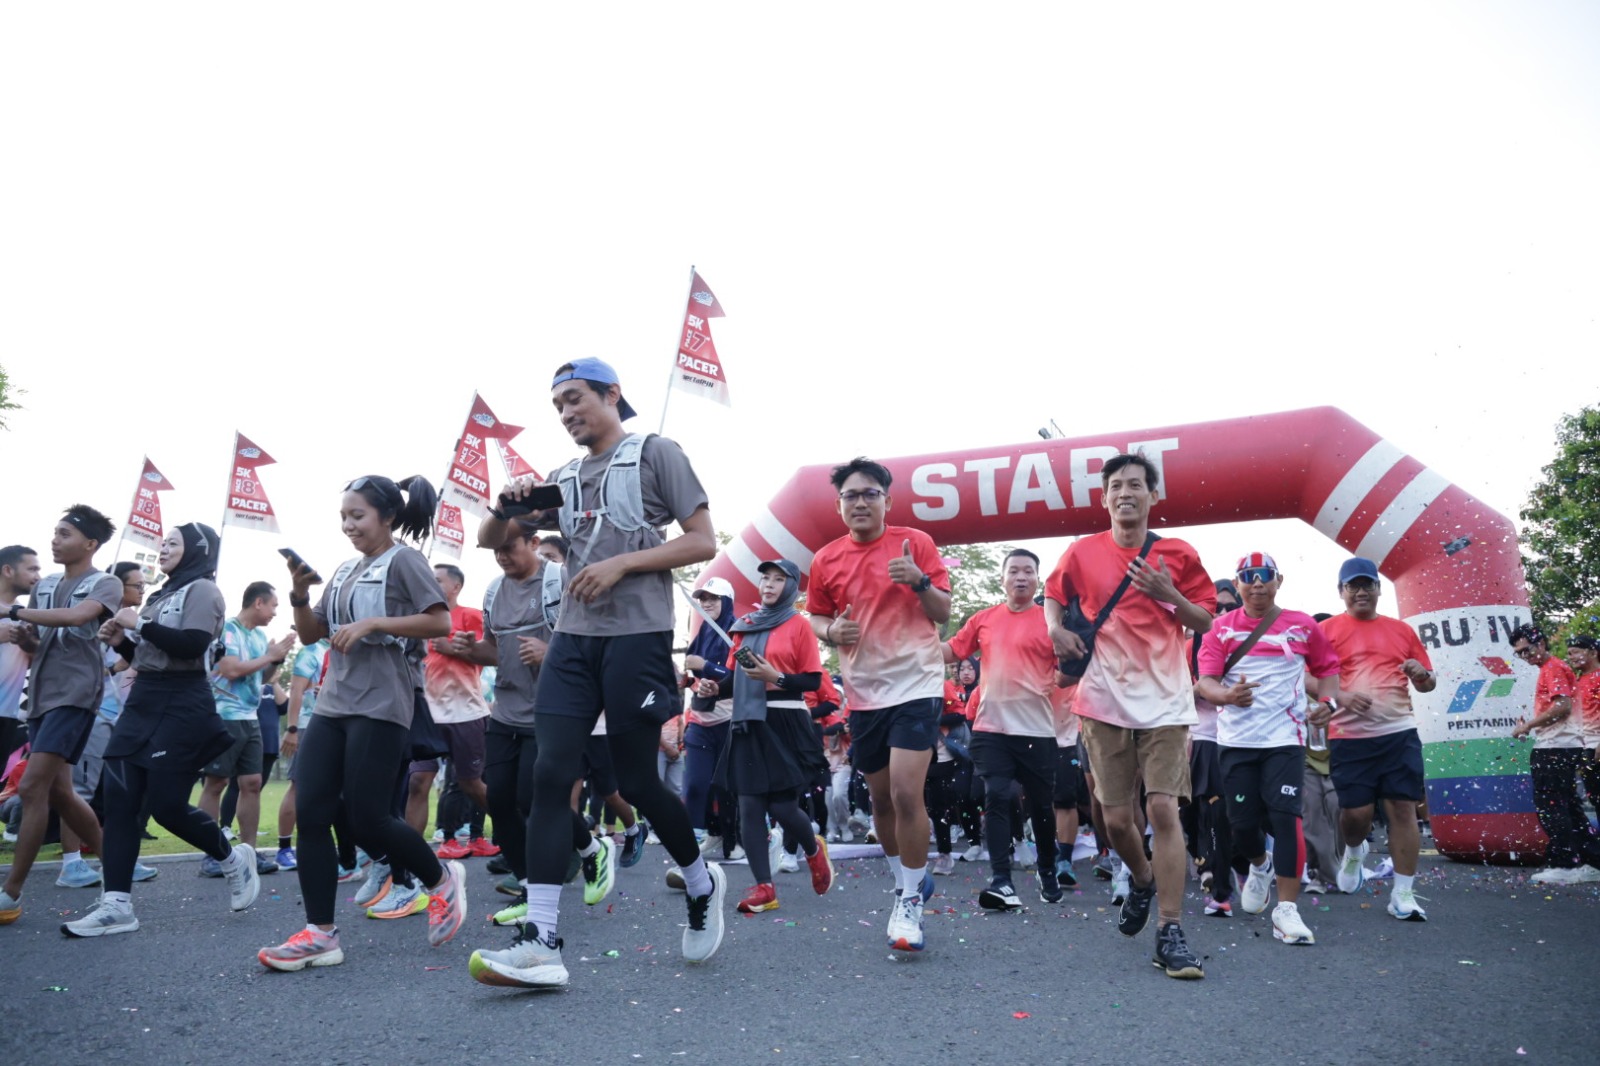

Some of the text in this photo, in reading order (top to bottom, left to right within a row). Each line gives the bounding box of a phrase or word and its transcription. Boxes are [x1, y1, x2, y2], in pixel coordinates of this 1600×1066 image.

[687, 314, 704, 331] 5K
[678, 353, 719, 376] PACER
[464, 433, 481, 450] 5K
[235, 466, 252, 478] 5K
[452, 467, 487, 493] PACER
[911, 437, 1179, 521] START
[140, 487, 154, 500] 5K
[231, 497, 268, 512] PACER
[131, 514, 161, 532] PACER
[438, 524, 463, 541] PACER
[1418, 615, 1520, 650] RU IV
[1447, 717, 1525, 730] PERTAMIN
